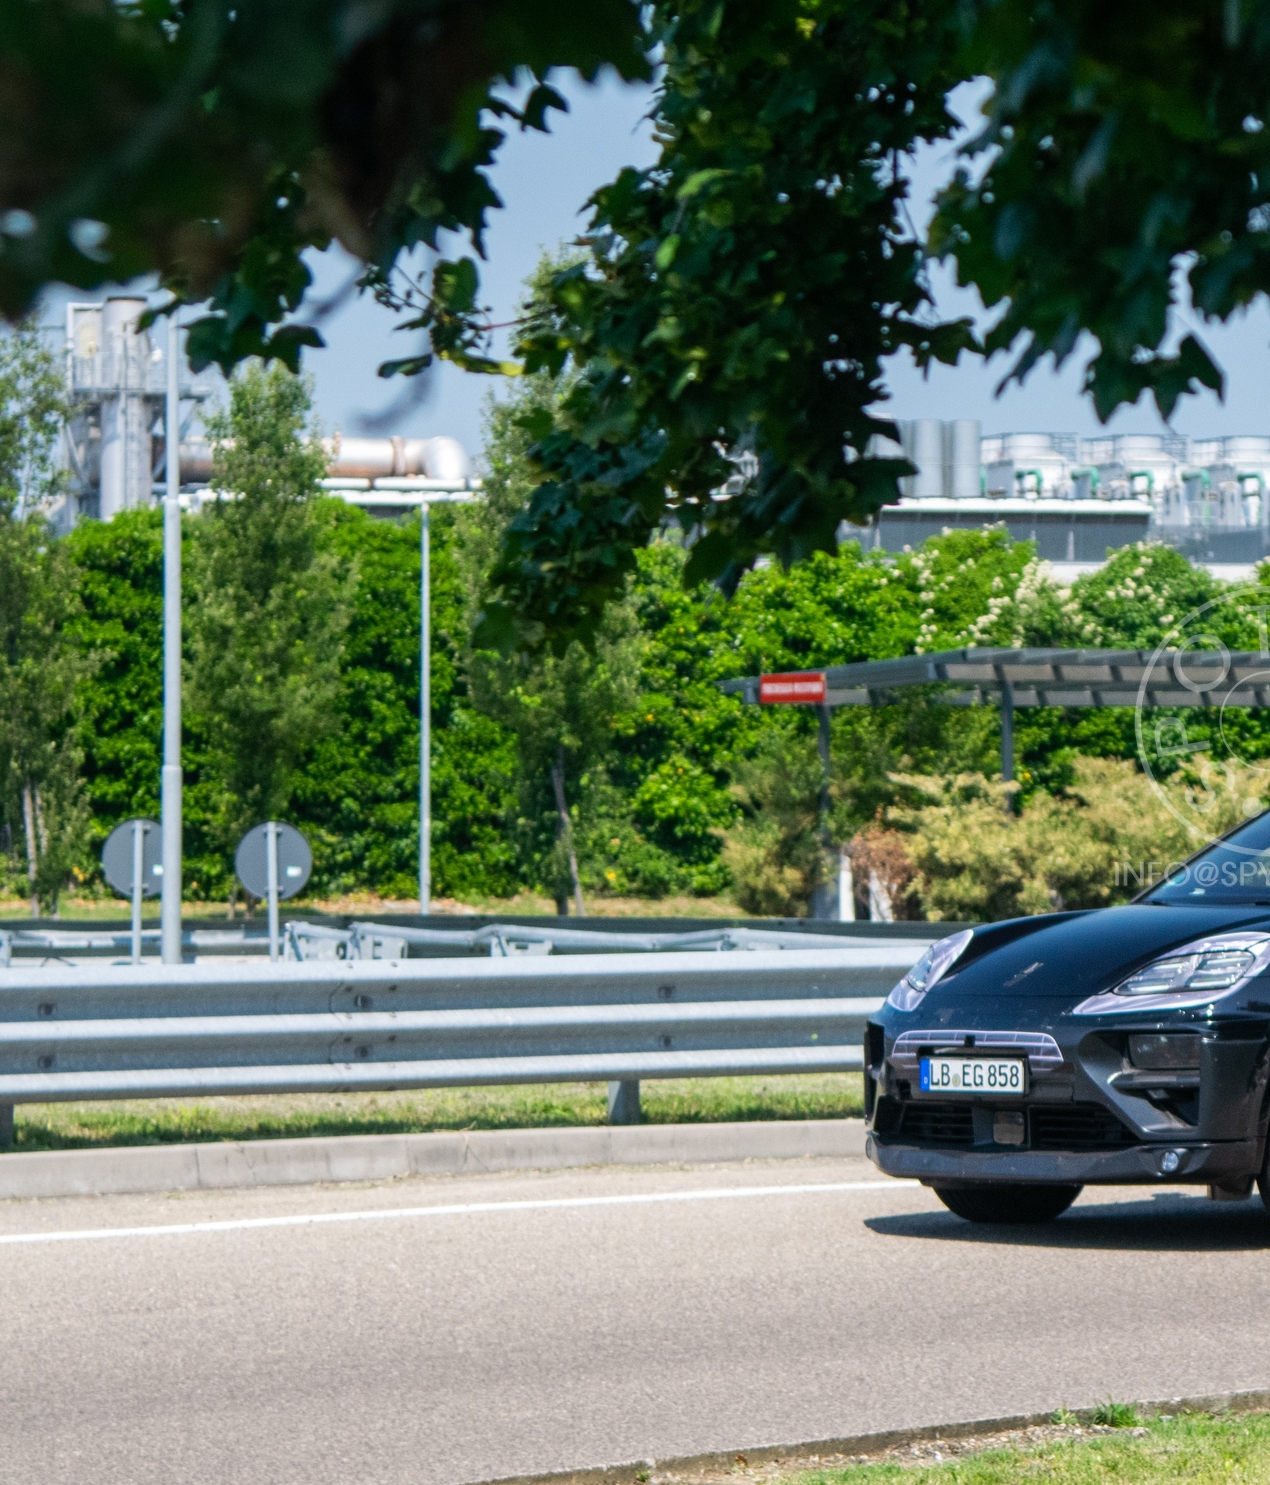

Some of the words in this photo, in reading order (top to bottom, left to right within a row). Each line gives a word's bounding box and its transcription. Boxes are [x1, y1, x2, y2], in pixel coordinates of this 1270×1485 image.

[930, 1063, 951, 1087] LB
[962, 1064, 984, 1087] EG
[988, 1064, 1019, 1087] 858
